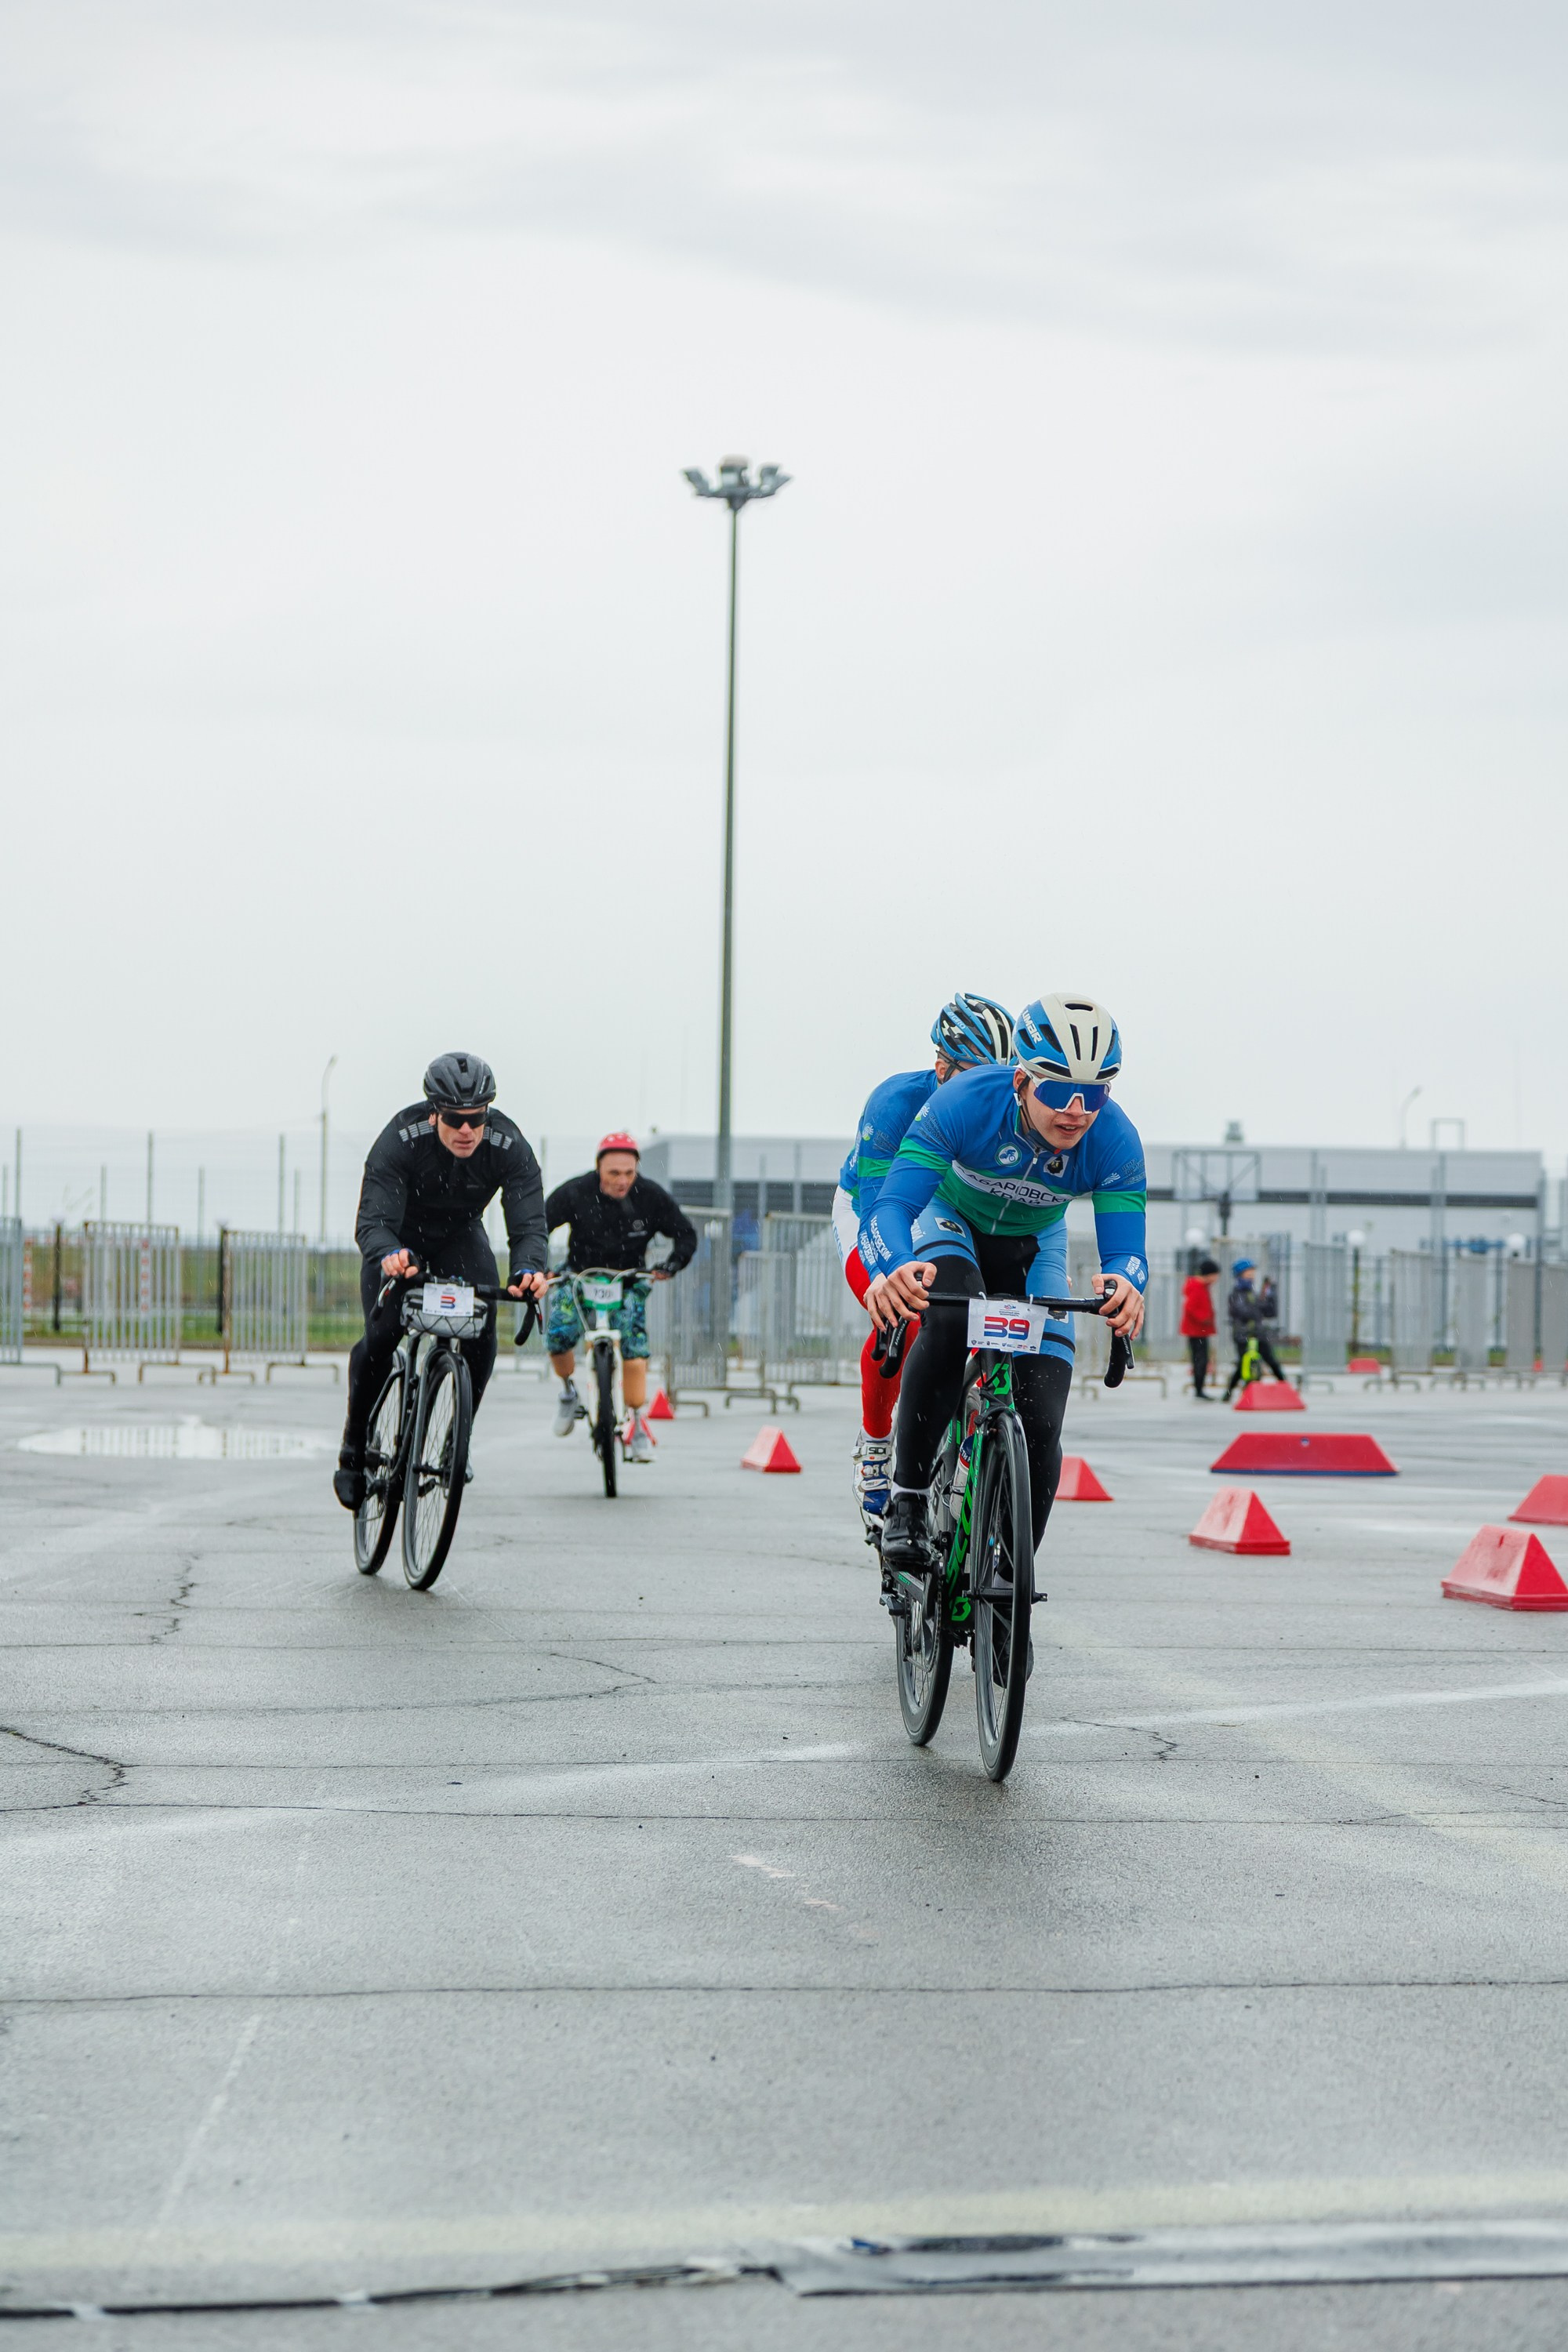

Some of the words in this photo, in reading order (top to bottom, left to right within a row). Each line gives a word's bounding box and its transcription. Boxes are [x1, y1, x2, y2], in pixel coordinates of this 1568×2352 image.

[951, 1014, 966, 1029] GIRO
[441, 1295, 456, 1308] 3
[984, 1316, 1030, 1341] 39
